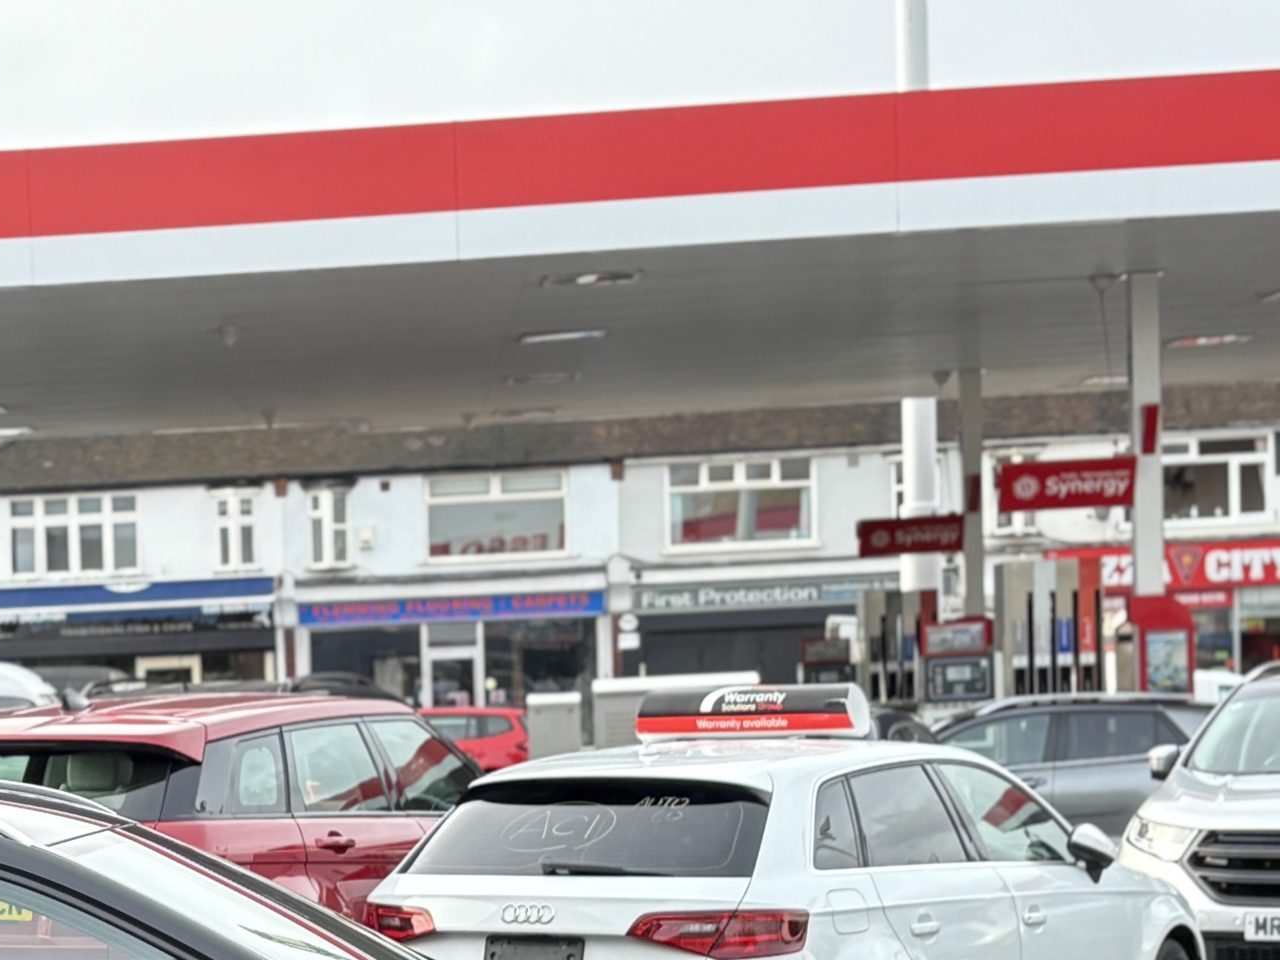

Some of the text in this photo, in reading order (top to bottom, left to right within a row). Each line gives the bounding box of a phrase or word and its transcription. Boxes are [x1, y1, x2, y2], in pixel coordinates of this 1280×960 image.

[1044, 475, 1130, 498] Synergy
[894, 529, 960, 547] Synergy
[640, 591, 694, 609] First
[698, 584, 819, 607] Protection
[722, 691, 787, 704] Warranty
[721, 703, 756, 712] Solutions
[696, 716, 788, 730] Warranty available
